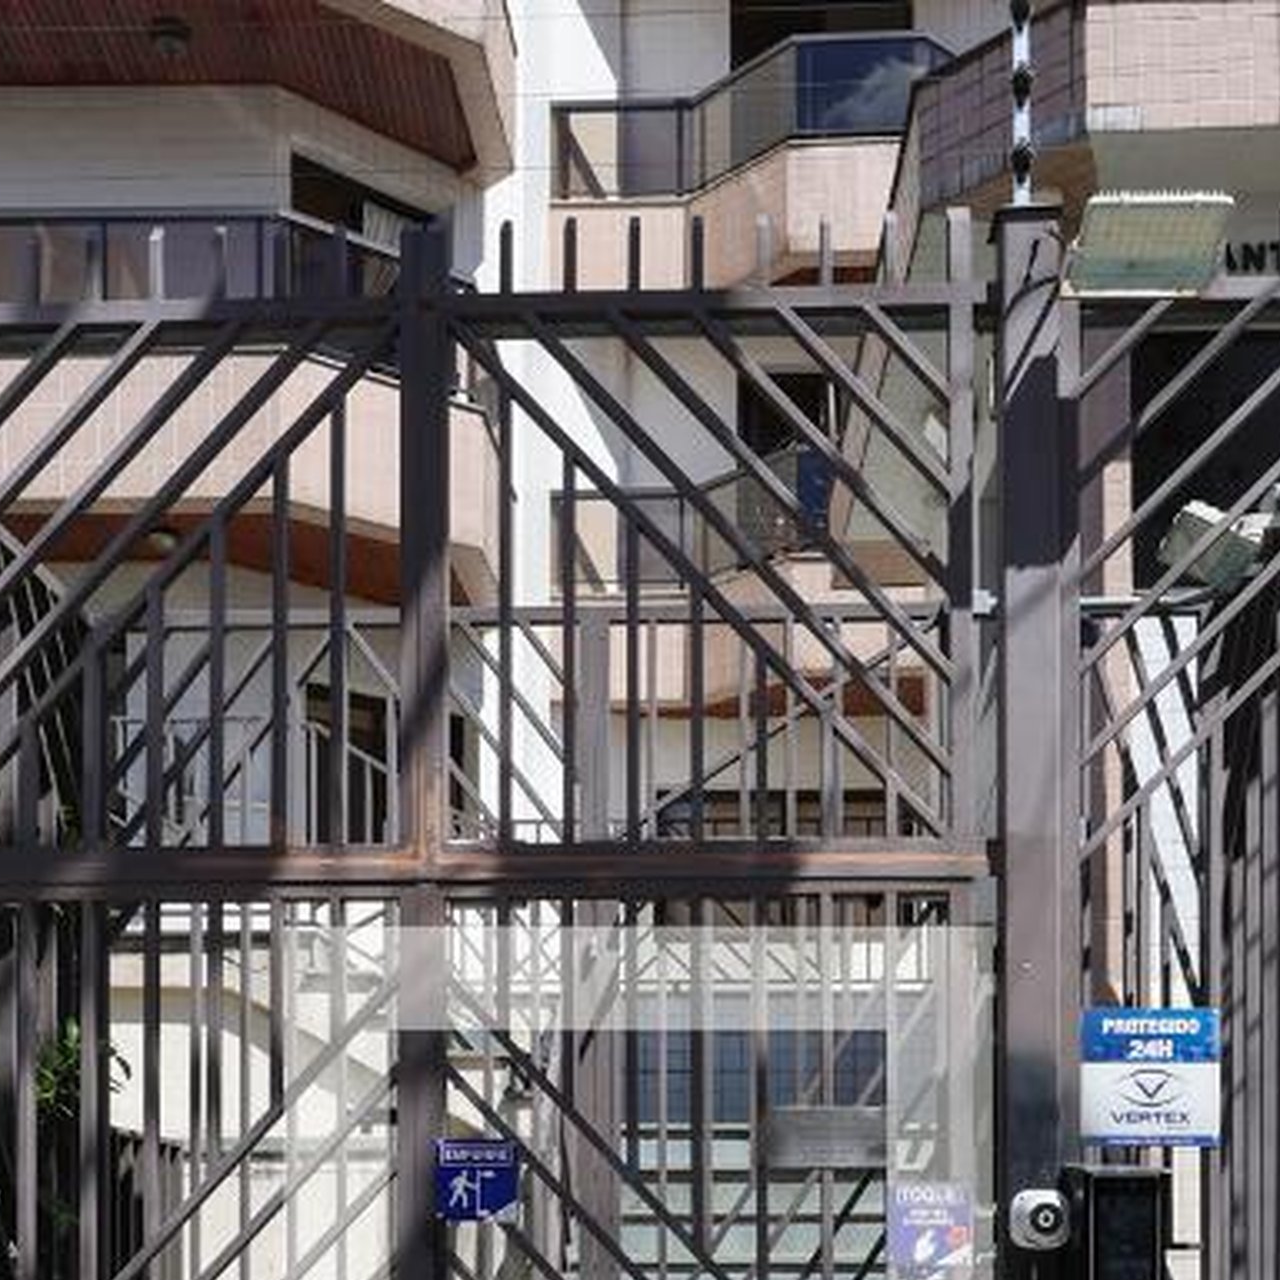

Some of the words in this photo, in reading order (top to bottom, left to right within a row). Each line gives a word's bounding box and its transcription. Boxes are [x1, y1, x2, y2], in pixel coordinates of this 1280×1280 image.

[1102, 1017, 1201, 1035] PROTEGIDO
[1128, 1039, 1174, 1058] 24H
[1110, 1111, 1191, 1125] VERTEX
